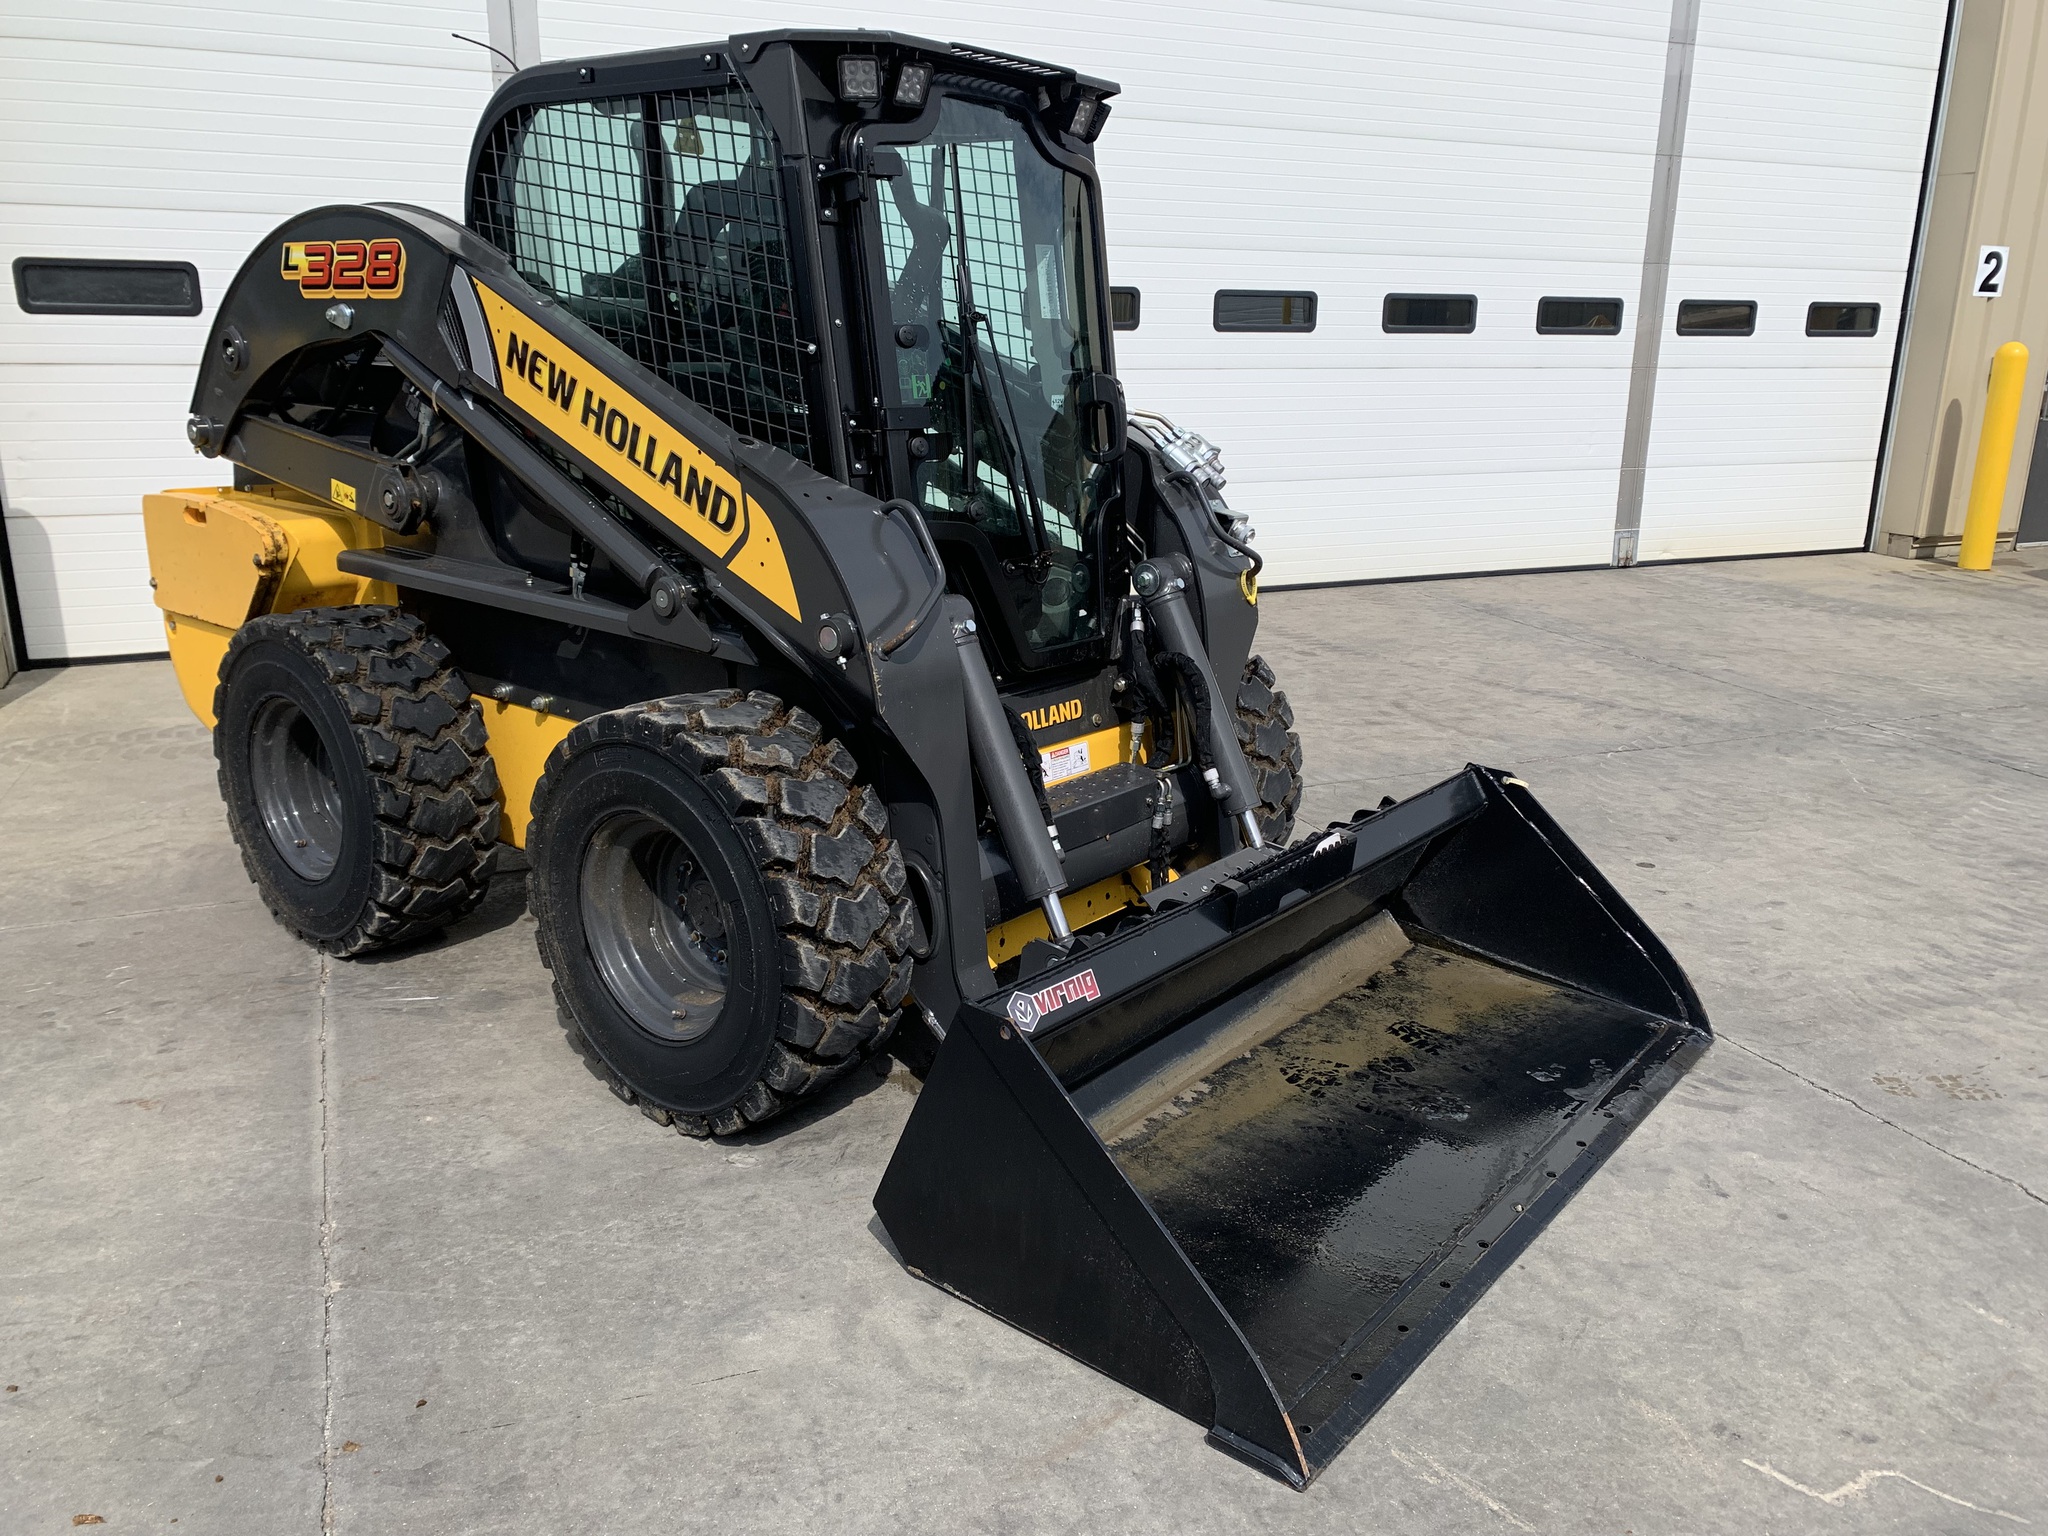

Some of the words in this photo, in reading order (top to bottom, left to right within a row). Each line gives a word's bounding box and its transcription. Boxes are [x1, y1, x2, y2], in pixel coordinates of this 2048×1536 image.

[282, 241, 403, 295] L328
[1978, 250, 2003, 293] 2
[505, 330, 577, 413] NEW
[580, 386, 738, 534] HOLLAND
